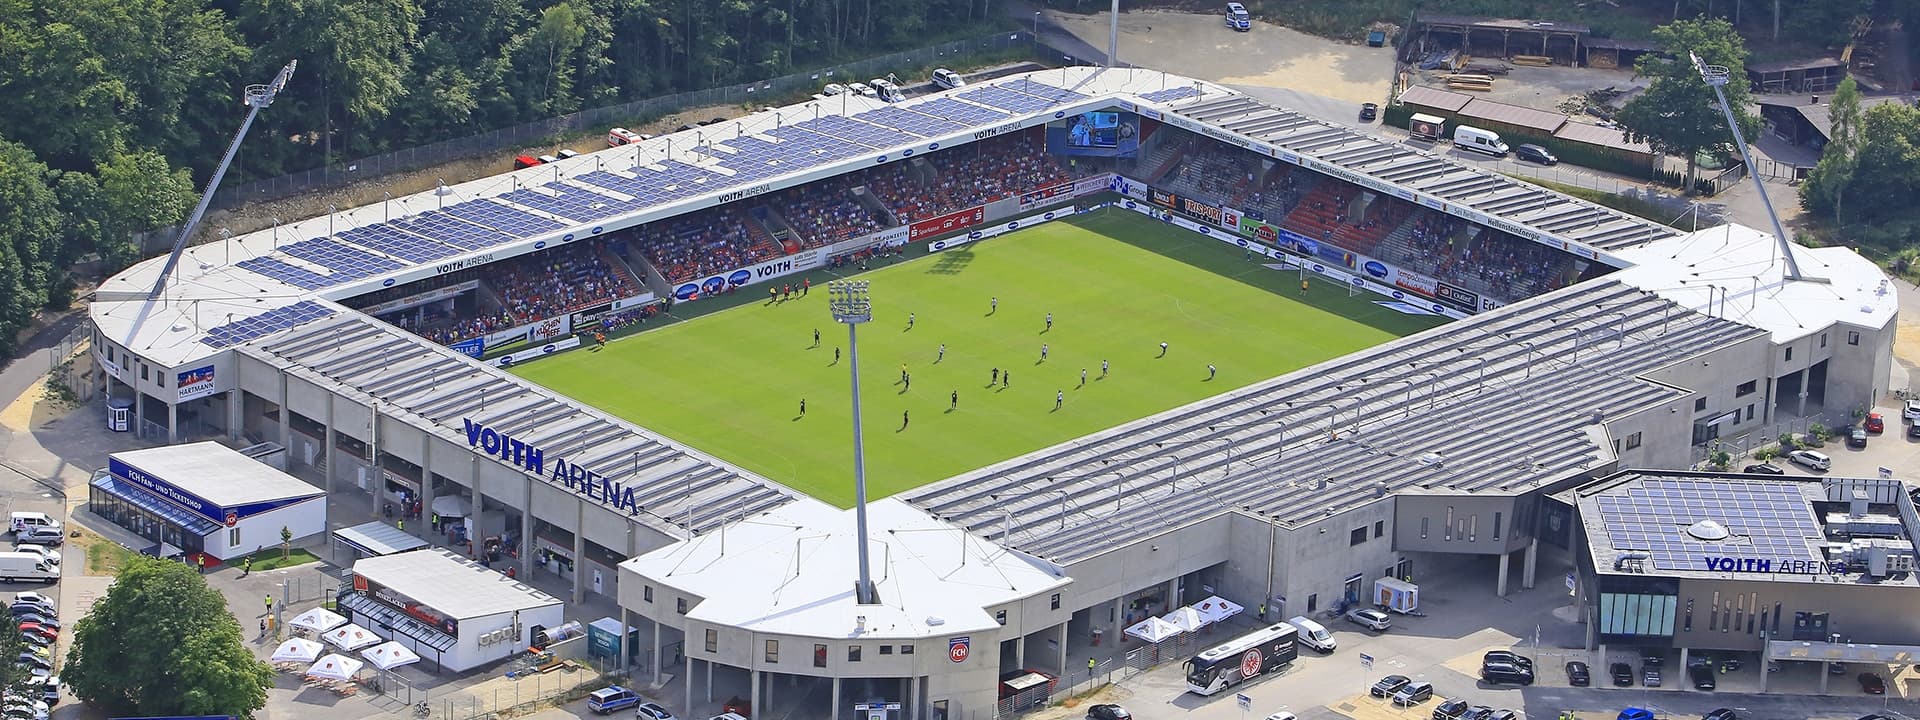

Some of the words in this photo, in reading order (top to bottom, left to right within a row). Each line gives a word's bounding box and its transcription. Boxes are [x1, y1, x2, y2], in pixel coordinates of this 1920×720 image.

[974, 127, 997, 139] VOITH
[999, 121, 1022, 132] ARENA
[718, 191, 743, 203] VOITH
[745, 184, 770, 196] ARENA
[1129, 185, 1147, 197] Group
[1185, 199, 1221, 219] TRISPORT
[918, 225, 940, 236] Sparkasse
[1243, 224, 1274, 238] TRAUB
[1487, 217, 1541, 241] HellensteinEnergie
[437, 262, 464, 274] VOITH
[466, 254, 494, 267] ARENA
[756, 261, 791, 278] VOITH
[179, 382, 214, 396] HARTMANN
[463, 417, 544, 476] VOITH
[551, 457, 639, 516] ARENA
[128, 470, 141, 483] FCH
[1704, 557, 1771, 573] VOITH
[1778, 559, 1846, 576] ARENA
[952, 648, 966, 657] FCH
